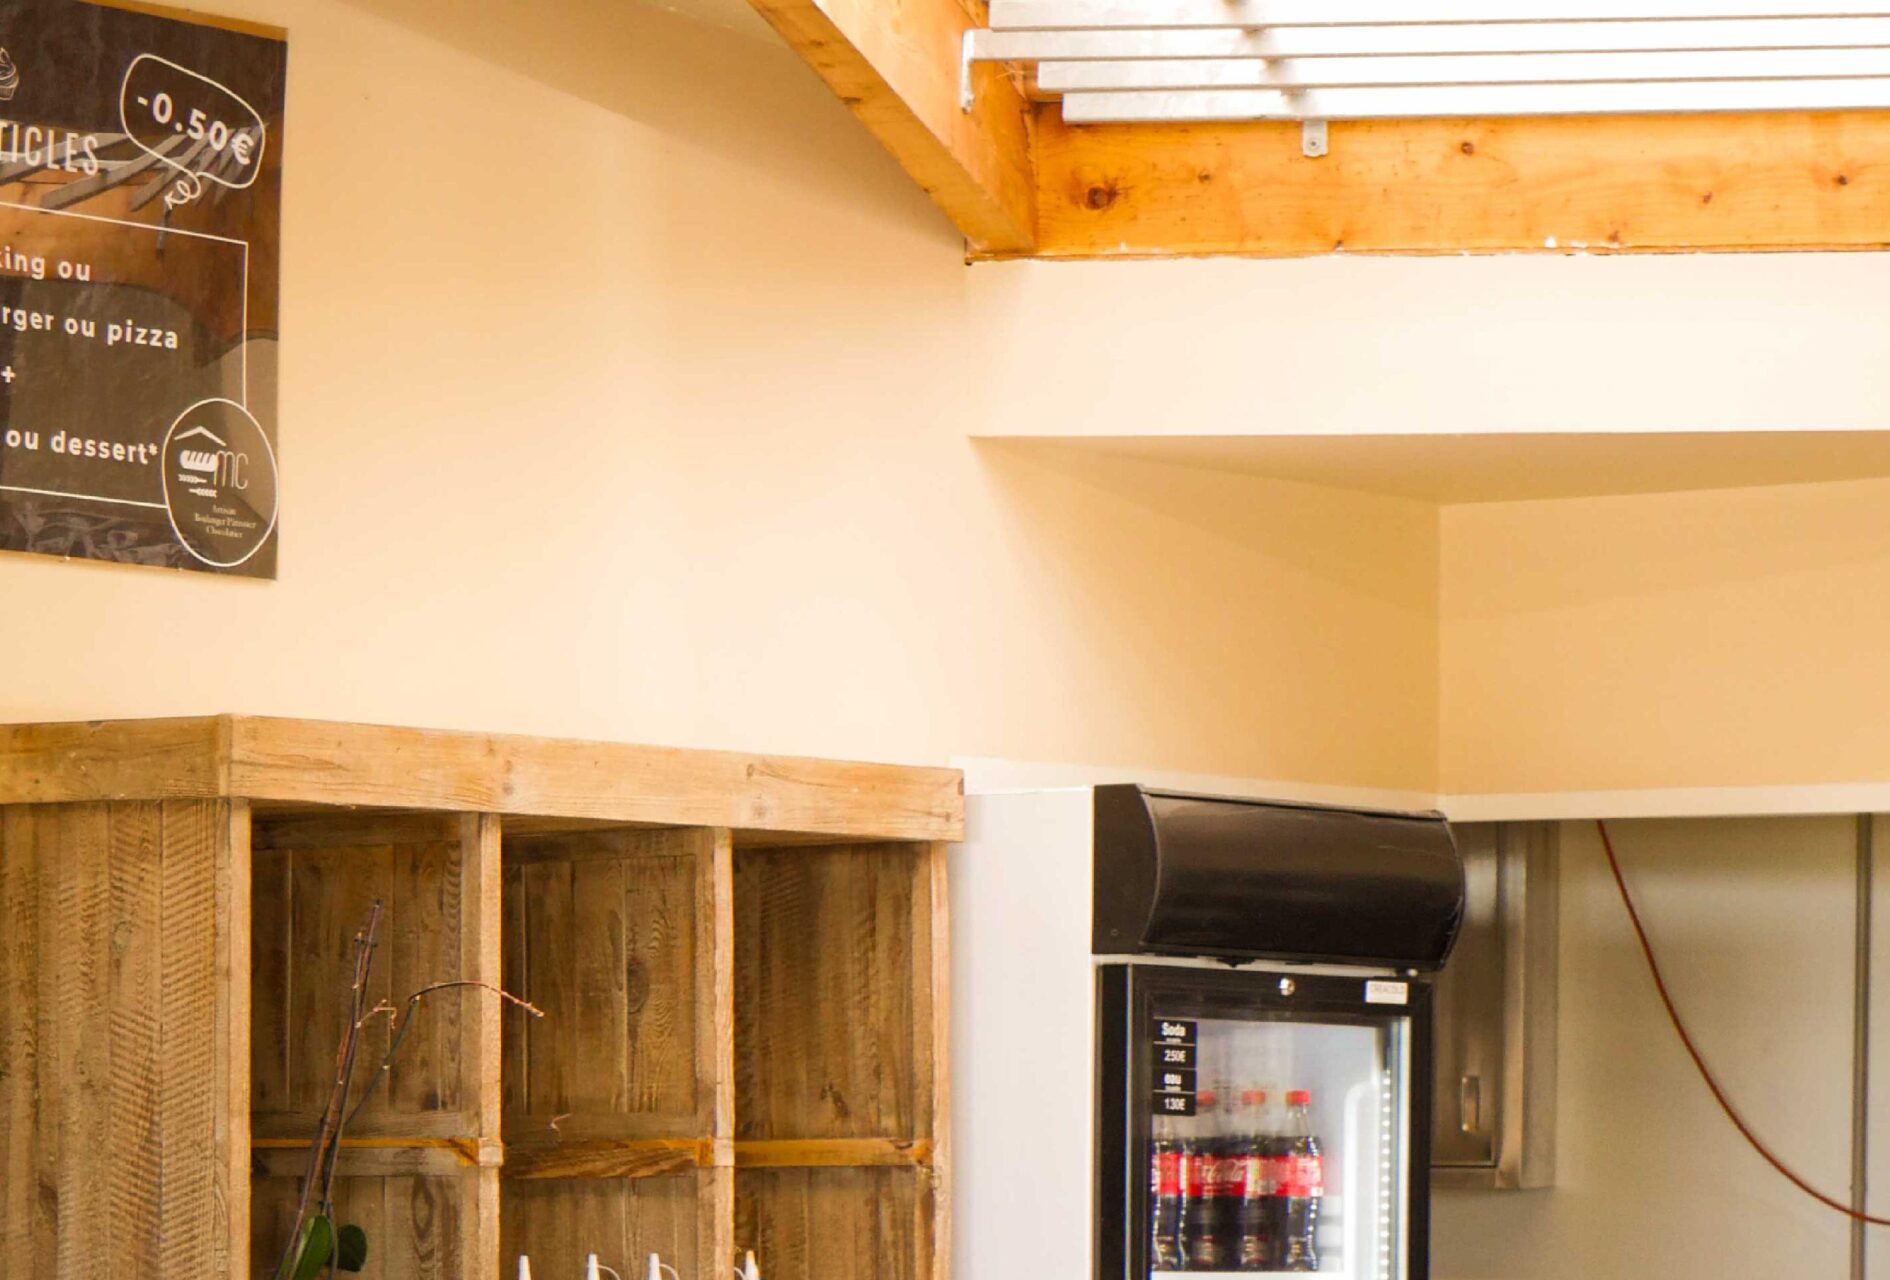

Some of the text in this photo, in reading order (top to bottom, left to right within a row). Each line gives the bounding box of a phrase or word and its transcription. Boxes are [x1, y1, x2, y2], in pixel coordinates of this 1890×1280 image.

[137, 93, 254, 165] -0.50€
[0, 246, 91, 282] ing ou
[64, 317, 96, 338] ou
[107, 319, 179, 350] pizza
[5, 428, 39, 450] ou
[1161, 1021, 1186, 1037] Soda
